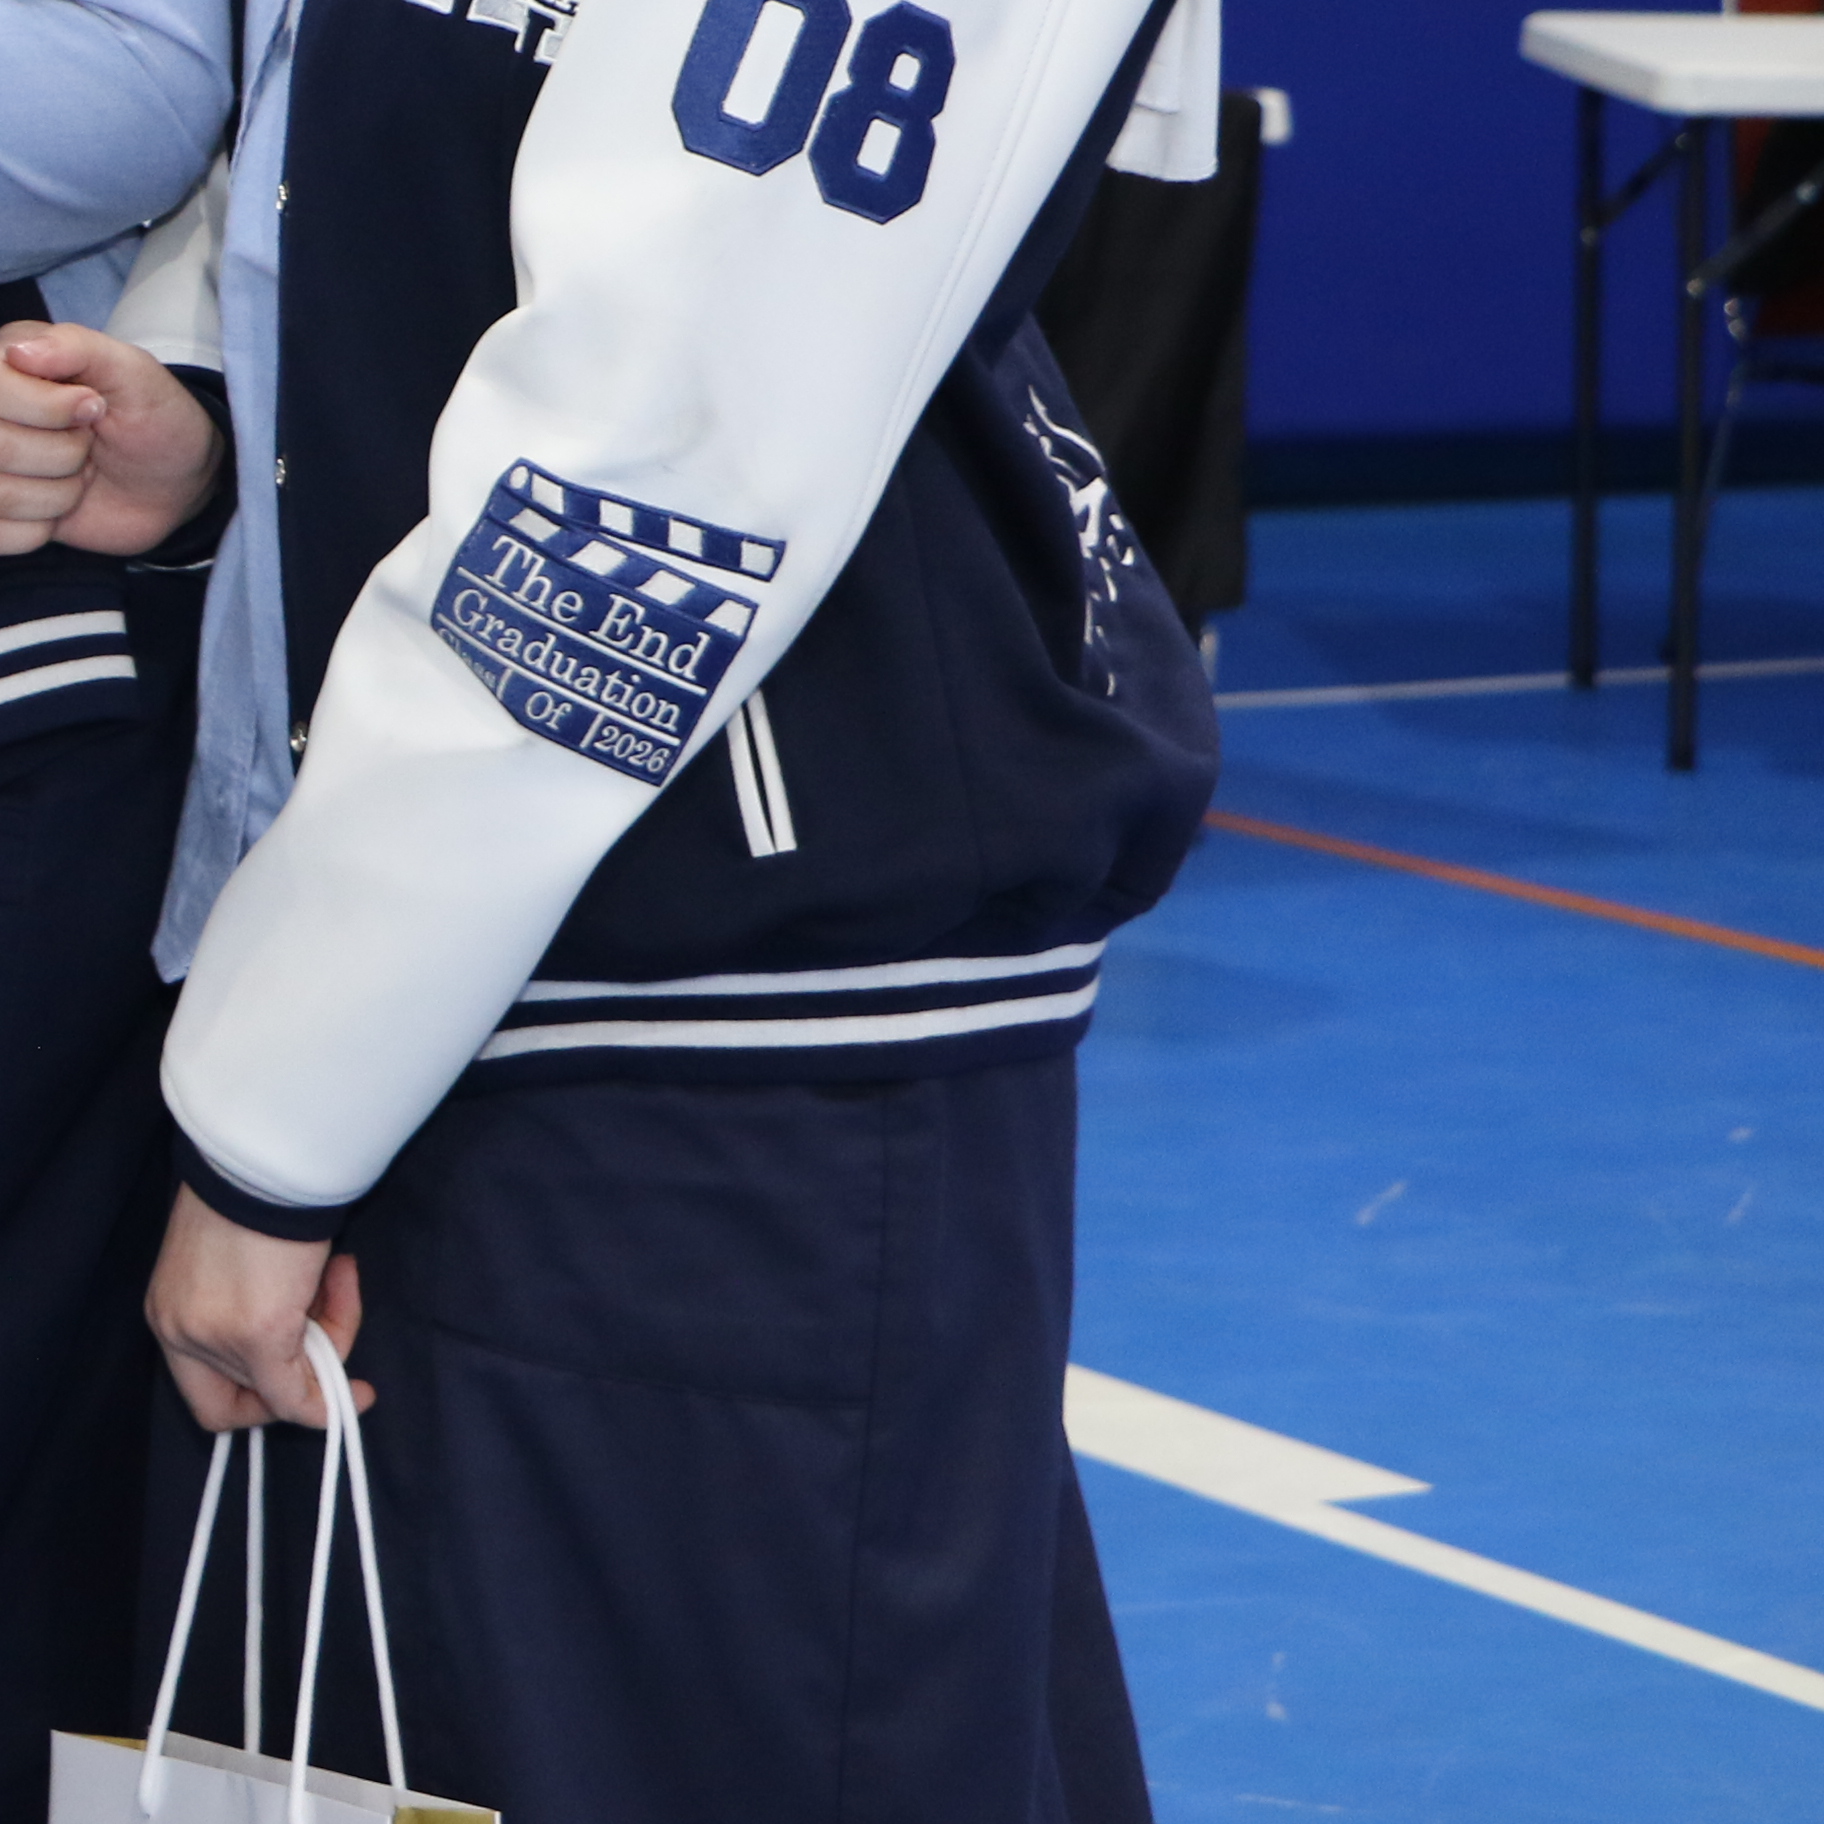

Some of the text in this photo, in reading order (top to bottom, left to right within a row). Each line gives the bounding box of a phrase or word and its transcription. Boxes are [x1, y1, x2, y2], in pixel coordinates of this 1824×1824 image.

[452, 587, 682, 733] Graduation
[484, 534, 584, 624] The
[590, 593, 710, 680] End
[524, 690, 671, 774] Of 2026
